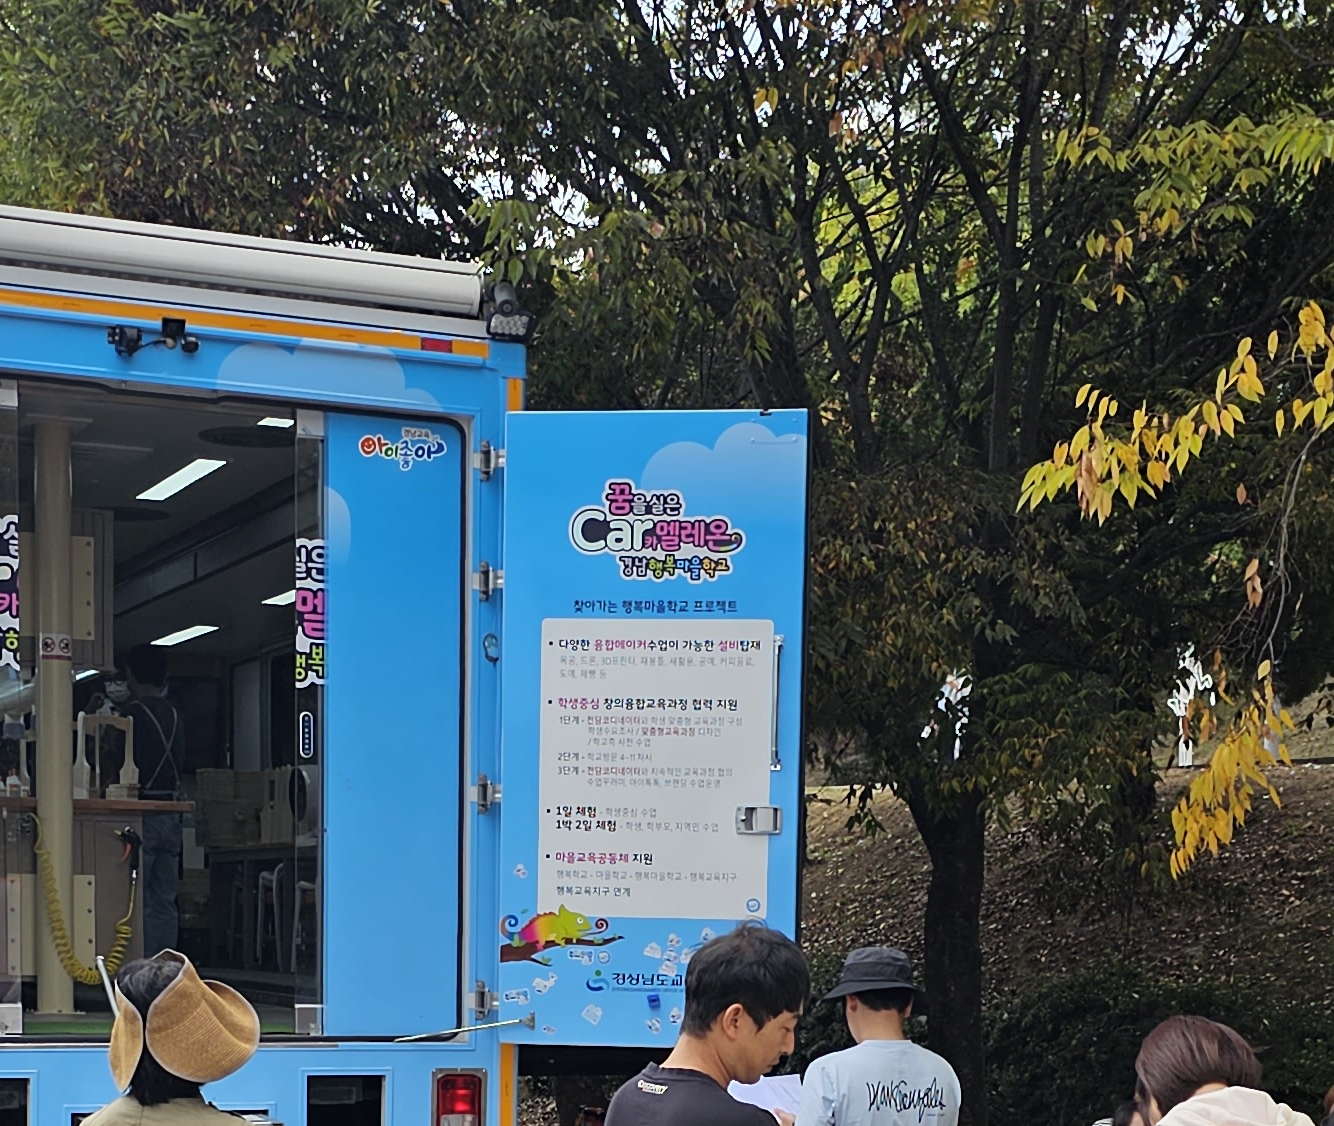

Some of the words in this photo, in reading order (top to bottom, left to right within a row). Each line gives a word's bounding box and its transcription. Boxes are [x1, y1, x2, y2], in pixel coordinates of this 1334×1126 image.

[361, 437, 445, 469] 아이좋아
[572, 509, 653, 551] Car
[620, 554, 729, 580] 경남행복마을학교
[574, 600, 617, 613] 찾아가는
[622, 600, 688, 613] 행복마을학교
[693, 600, 738, 613] 프로젝트
[559, 639, 590, 651] 다양한
[682, 639, 714, 652] 가능한
[718, 639, 761, 652] 설비탑재
[558, 698, 599, 710] 학생중심
[604, 698, 688, 711] 창의융합교육과정
[692, 699, 713, 711] 협력
[717, 699, 738, 711] 지원
[556, 806, 572, 817] 1일
[576, 806, 596, 818] 체험
[576, 820, 592, 830] 2일
[596, 820, 616, 832] 체험
[555, 852, 629, 864] 마을교육공동체
[633, 853, 653, 865] 지원
[557, 886, 610, 896] 행복교육지구
[614, 887, 631, 897] 연계
[612, 972, 683, 986] 경상남도교
